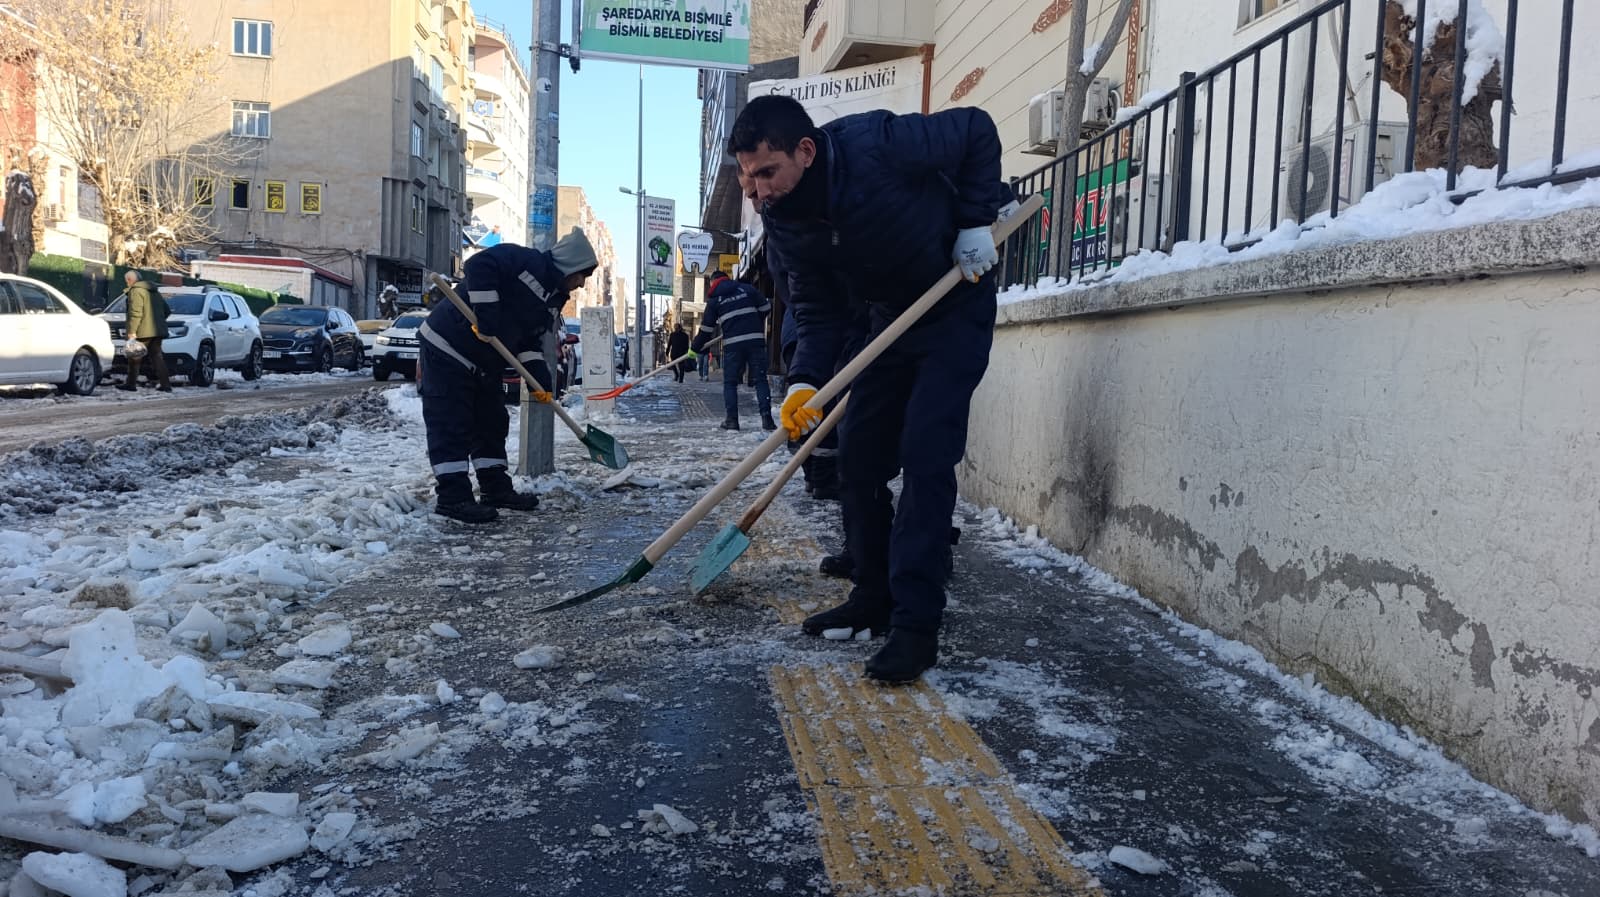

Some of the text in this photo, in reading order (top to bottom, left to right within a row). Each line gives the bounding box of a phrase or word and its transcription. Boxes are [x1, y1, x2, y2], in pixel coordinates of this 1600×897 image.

[602, 7, 733, 27] ŞAREDARIYA BISMILÊ
[609, 24, 724, 43] BİSMİL BELEDİYESİ
[790, 66, 896, 101] ELİT DİŞ KLİNİĞİ
